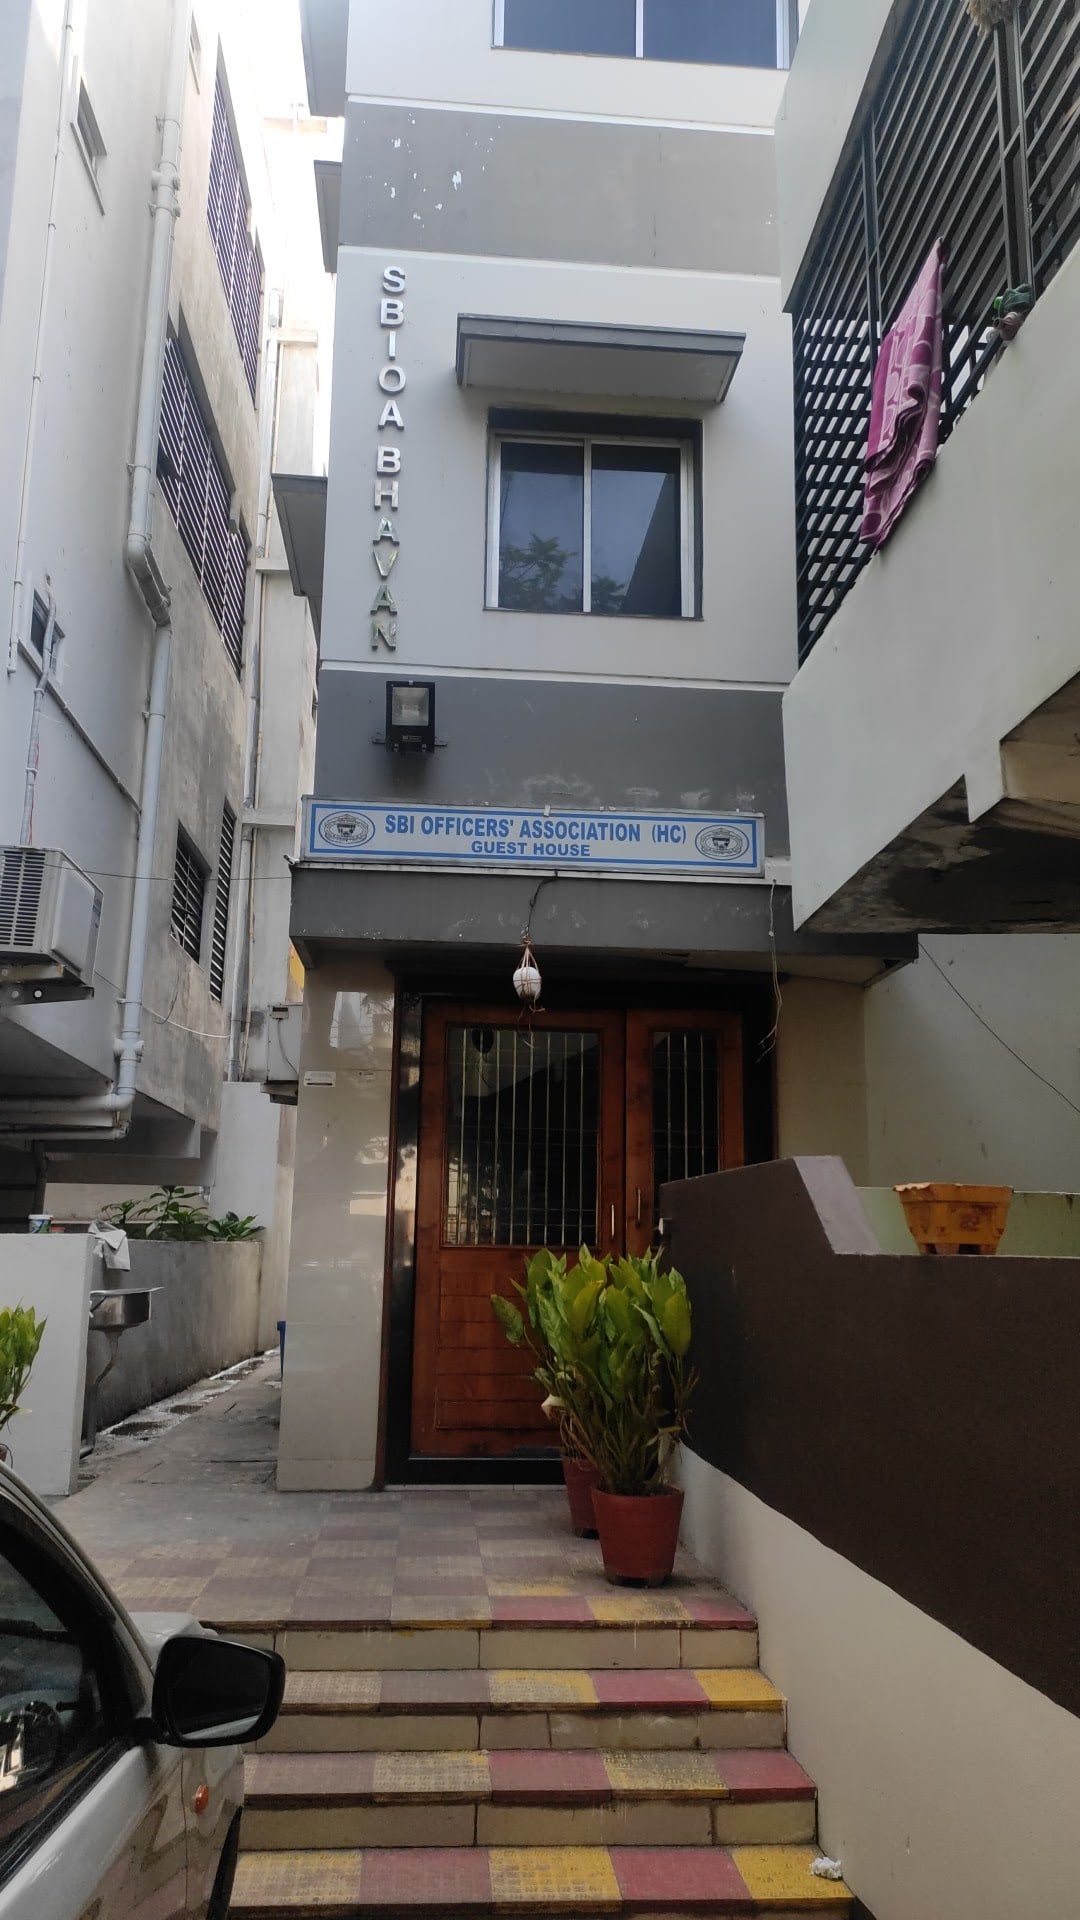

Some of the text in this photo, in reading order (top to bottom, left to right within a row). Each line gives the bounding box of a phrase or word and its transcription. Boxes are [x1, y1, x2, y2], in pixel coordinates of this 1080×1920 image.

[370, 265, 407, 651] SBIOA BHAVAN
[385, 814, 415, 834] SBI
[421, 815, 514, 838] OFFICERS'
[519, 819, 641, 842] ASSOCIATION
[651, 823, 687, 845] (HC)
[471, 840, 591, 857] GUEST HOUSE
